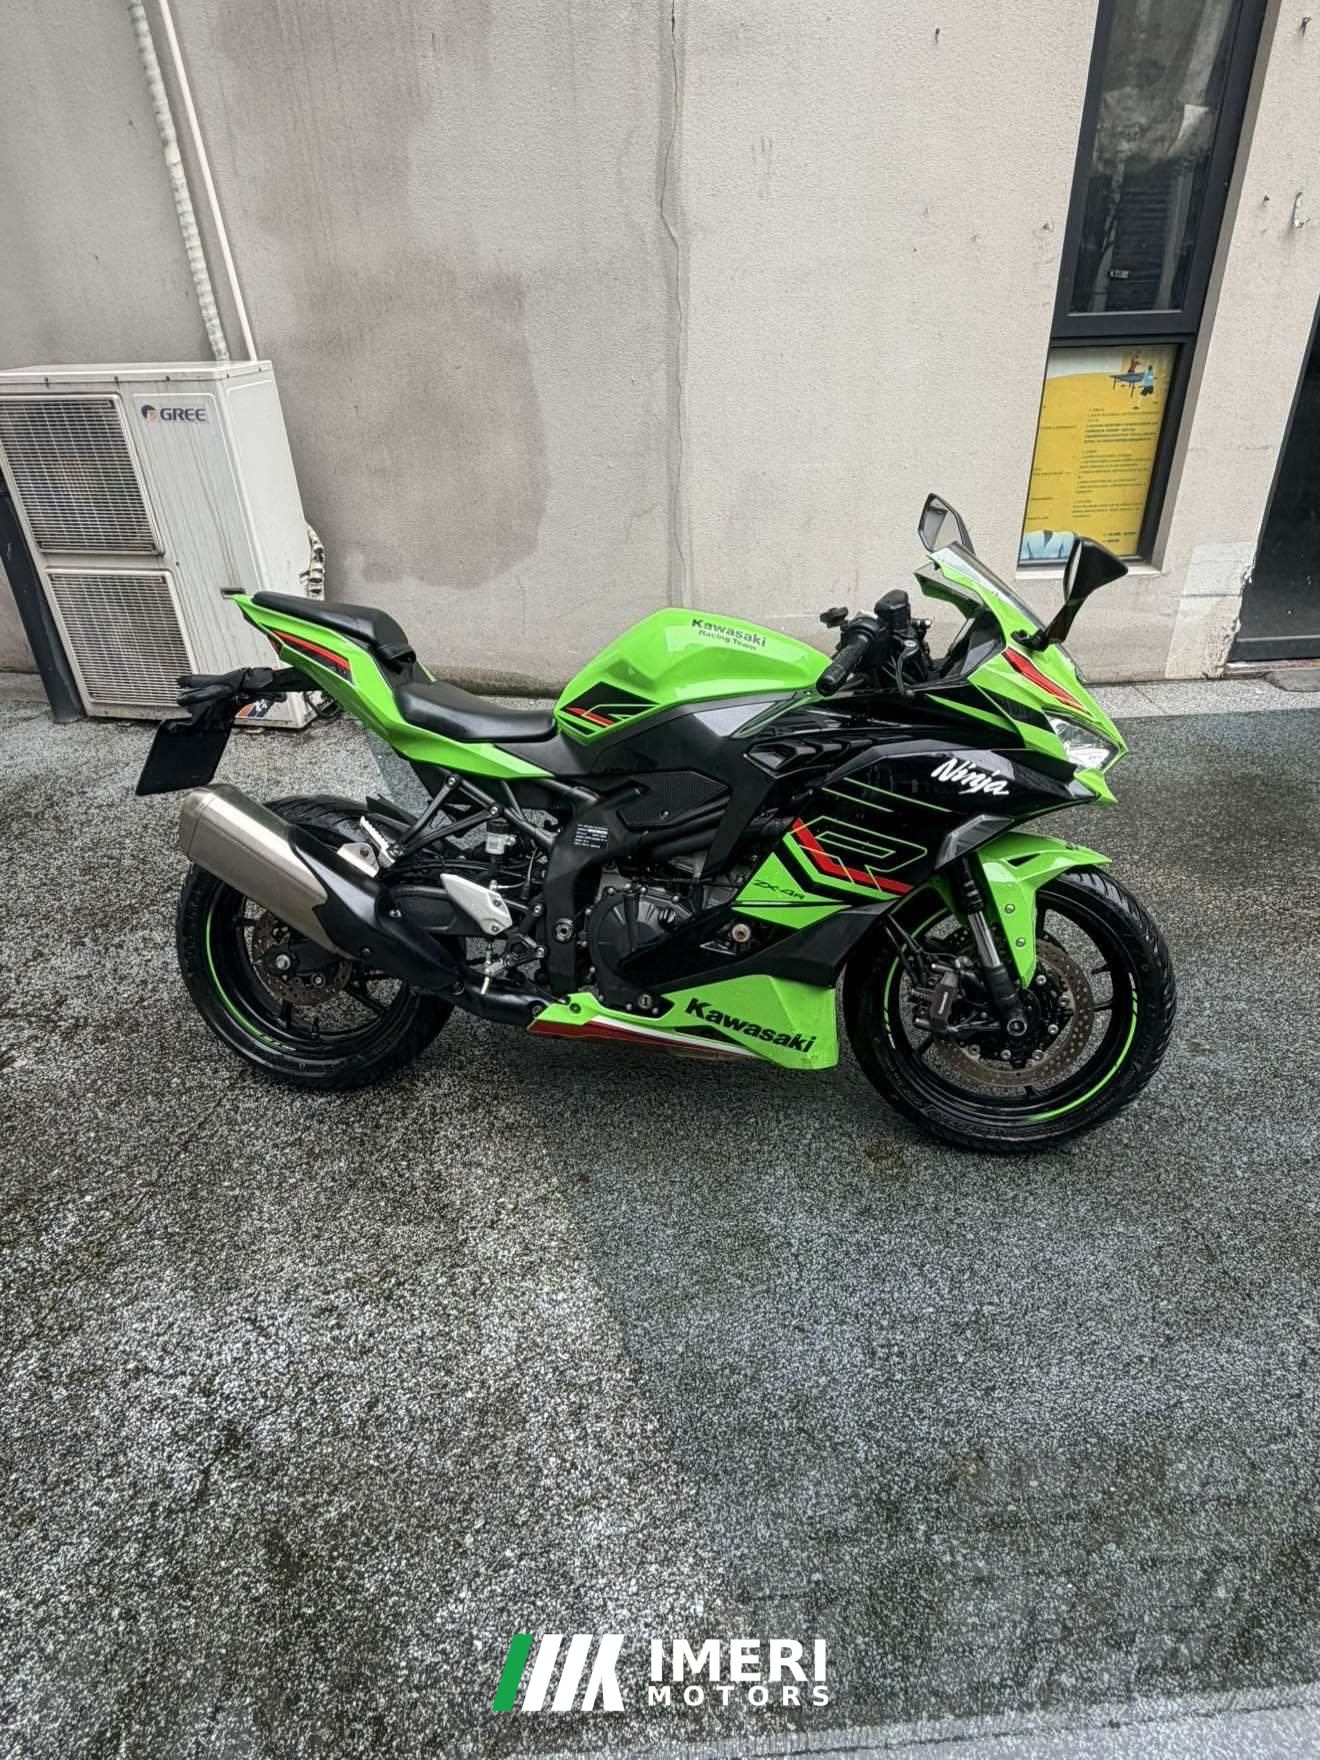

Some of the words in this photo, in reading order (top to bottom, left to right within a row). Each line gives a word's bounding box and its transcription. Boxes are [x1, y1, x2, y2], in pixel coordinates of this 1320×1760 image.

[160, 407, 206, 422] GREE
[691, 618, 767, 647] Kawasaki
[698, 629, 731, 643] Racing
[732, 638, 757, 651] Team
[930, 758, 1009, 795] Ninja
[685, 997, 817, 1053] Kawasaki
